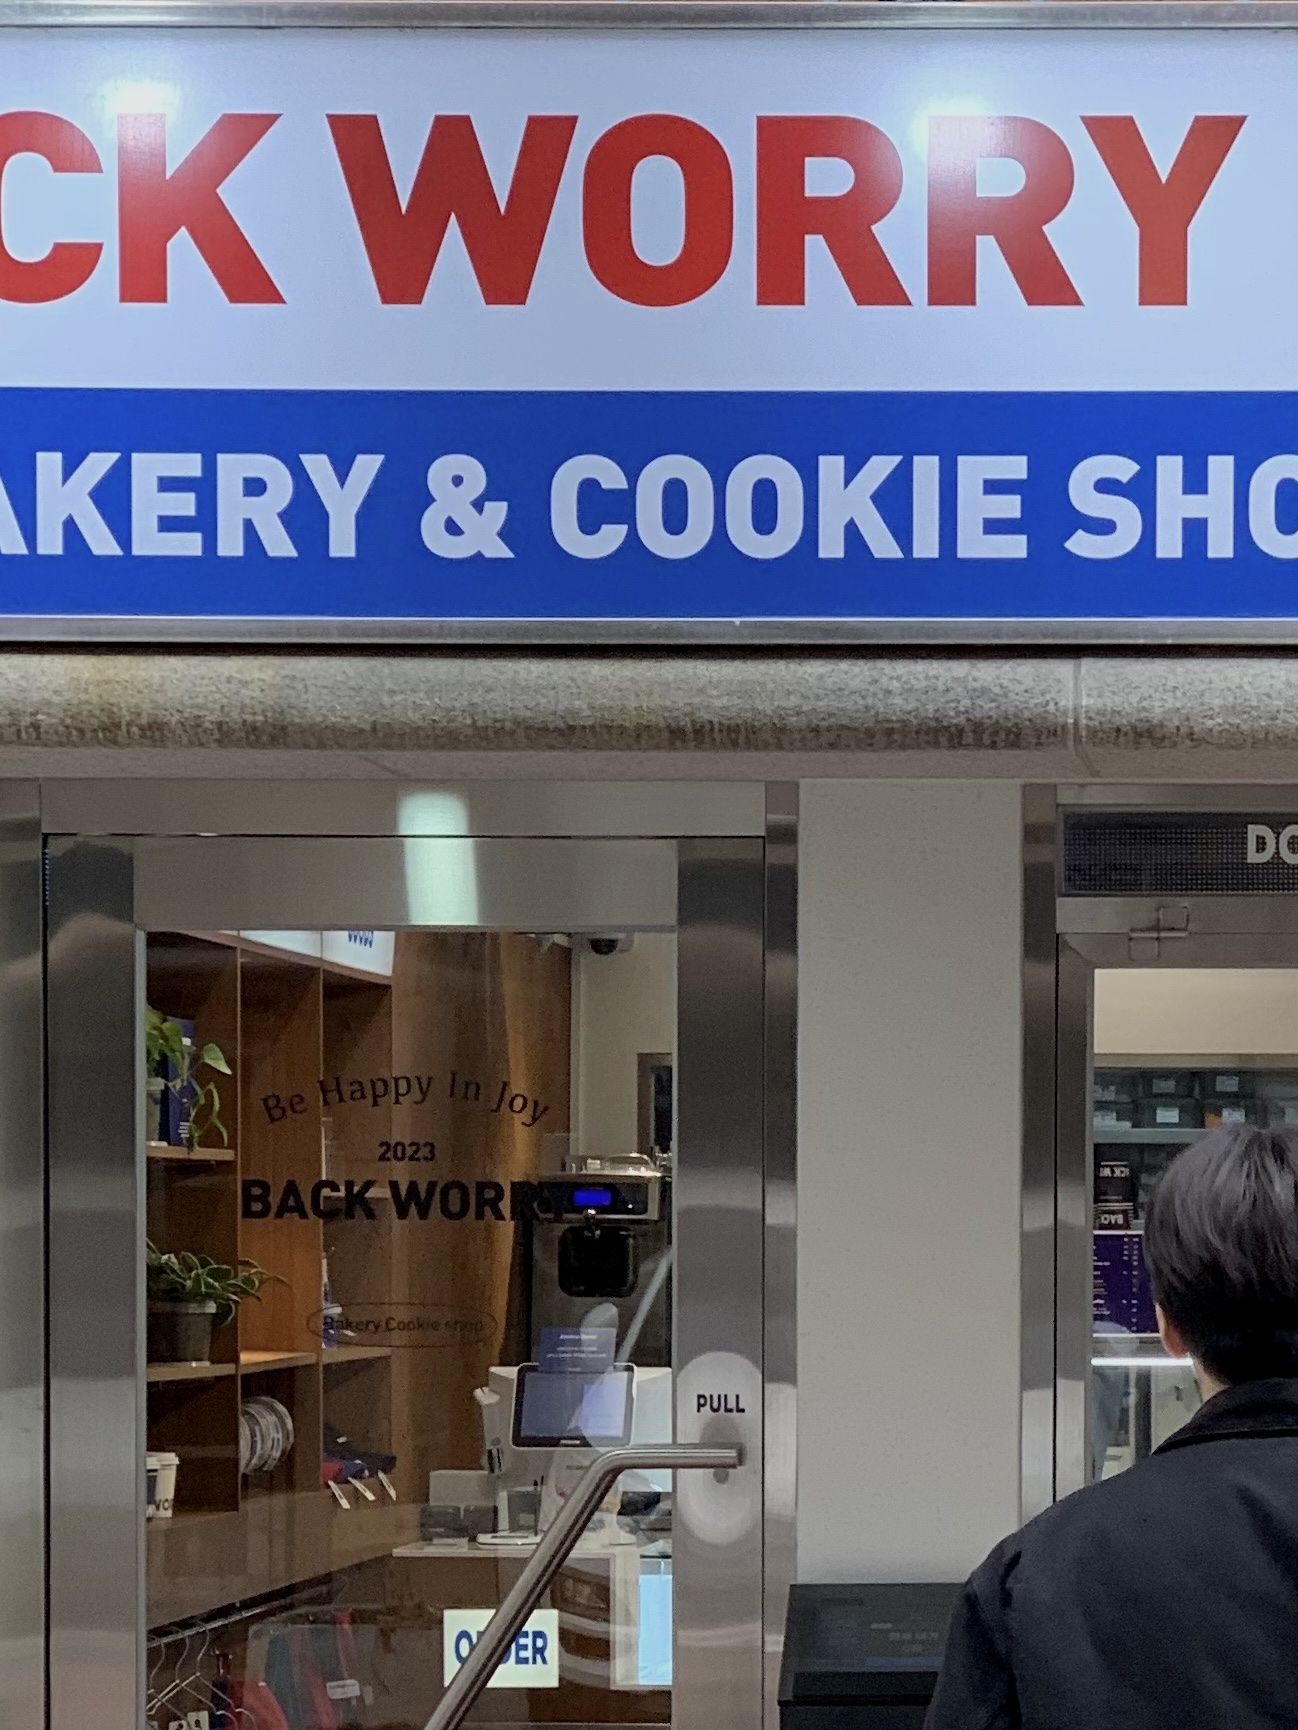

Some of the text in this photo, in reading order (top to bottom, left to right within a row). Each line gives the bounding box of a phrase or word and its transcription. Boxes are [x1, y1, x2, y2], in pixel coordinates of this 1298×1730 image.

[326, 114, 1248, 307] WORRY
[0, 452, 384, 558] KERY
[420, 454, 514, 560] &
[550, 455, 1028, 559] COOKIE
[261, 1072, 551, 1128] Be Happy In Joy
[377, 1141, 437, 1162] 2023
[241, 1179, 377, 1221] BACK
[385, 1316, 439, 1332] Cookie
[697, 1394, 745, 1413] PULL
